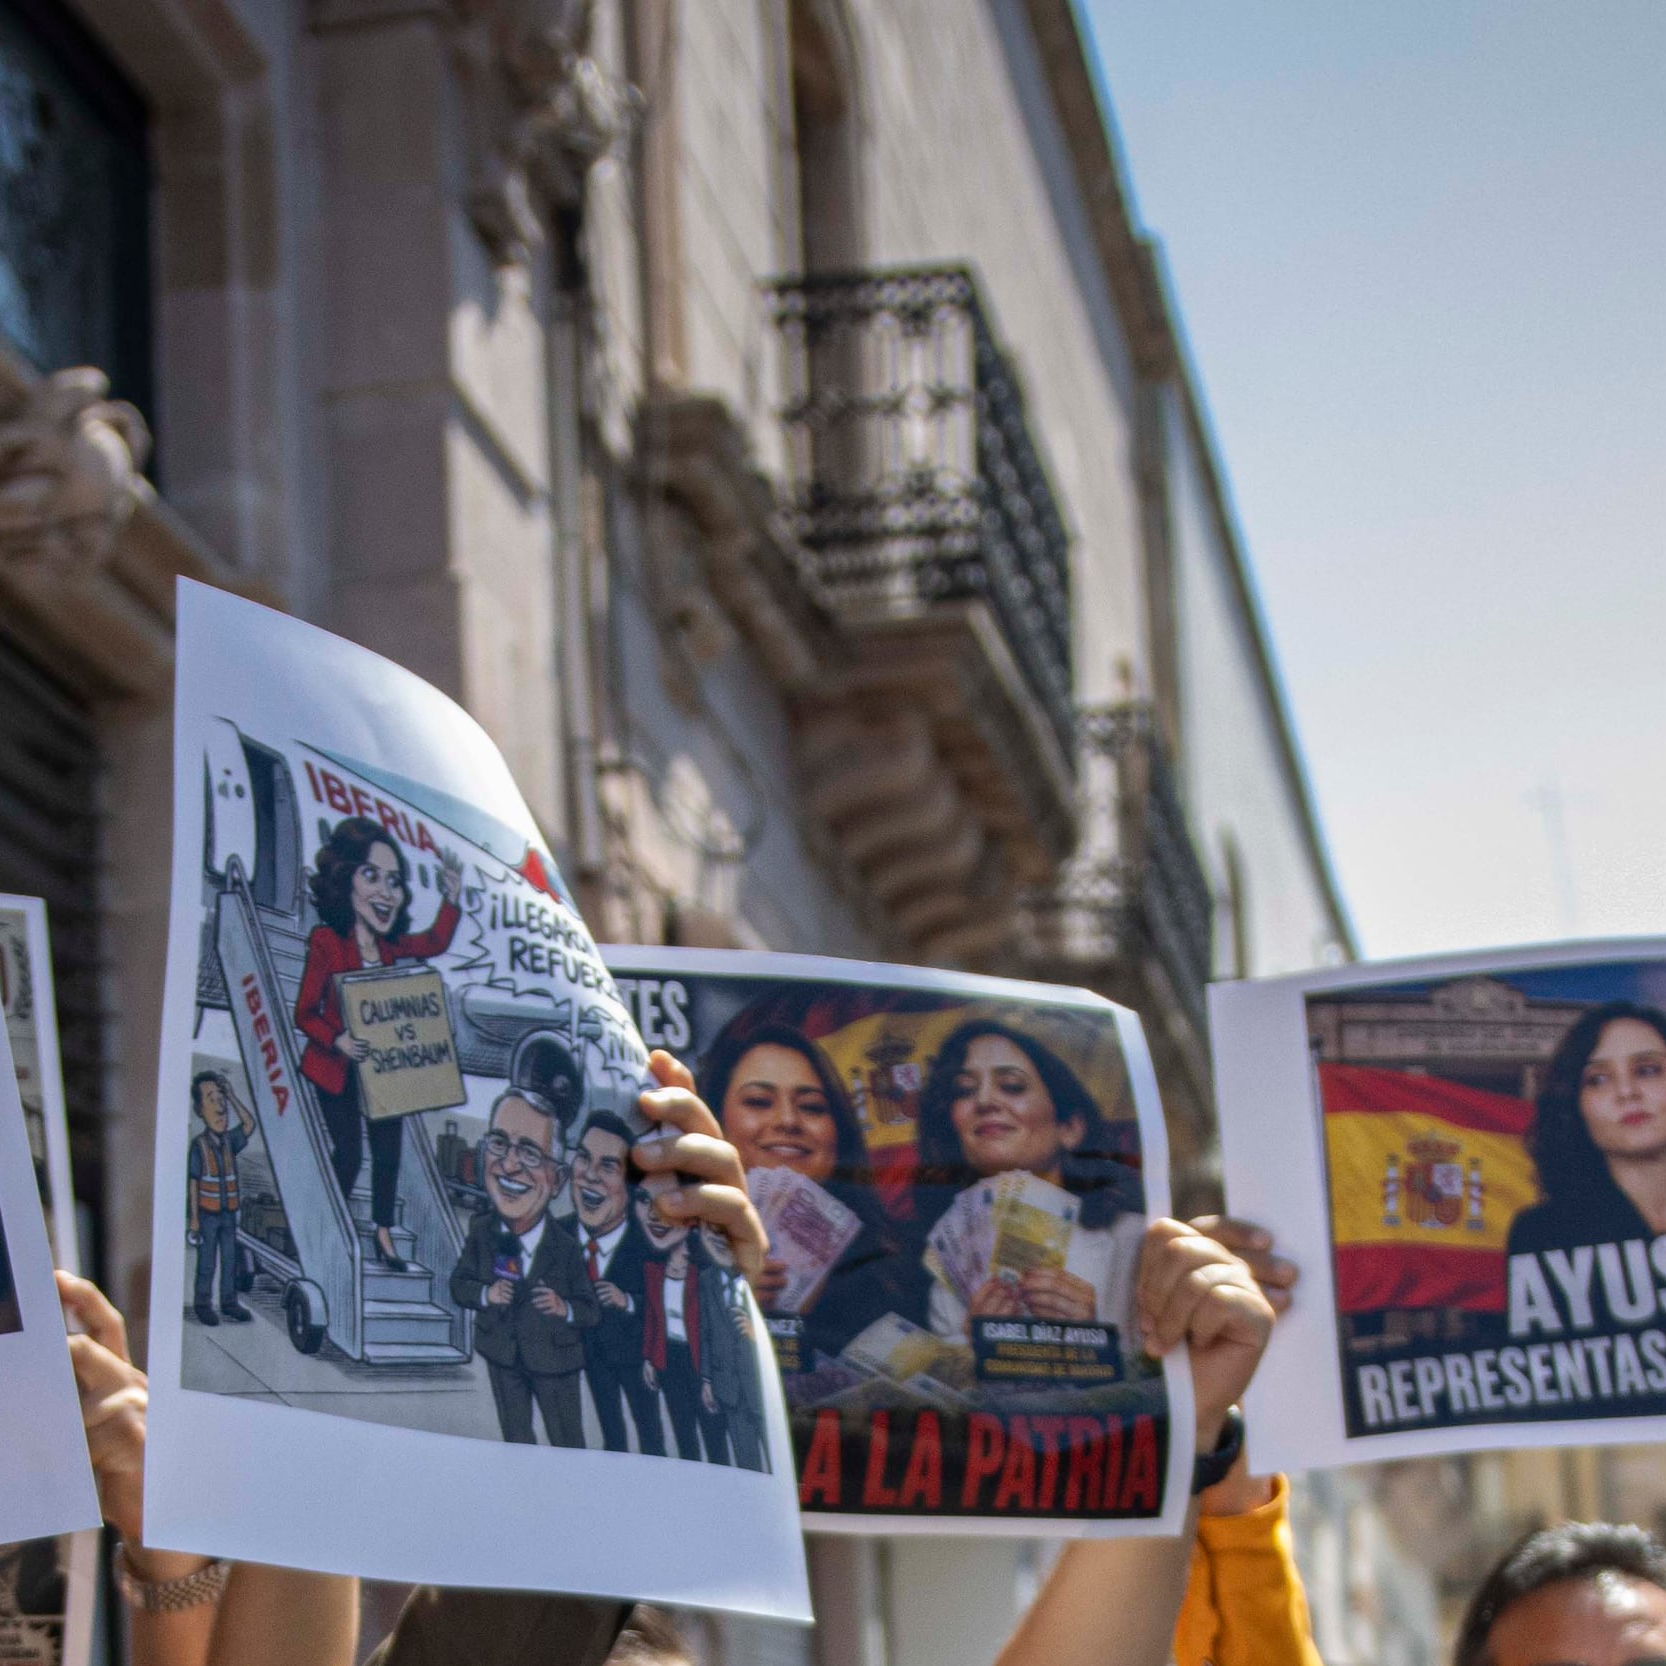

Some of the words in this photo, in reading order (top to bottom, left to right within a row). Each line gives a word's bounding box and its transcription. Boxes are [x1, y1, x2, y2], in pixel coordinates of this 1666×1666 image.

[304, 761, 442, 854] IBERIA
[360, 993, 440, 1024] CALUMNIAS
[394, 1022, 417, 1041] VS
[241, 973, 289, 1117] IBERIA
[370, 1042, 452, 1074] SHEINBAUM
[862, 1409, 942, 1508] LA
[960, 1410, 1157, 1511] PATRIA
